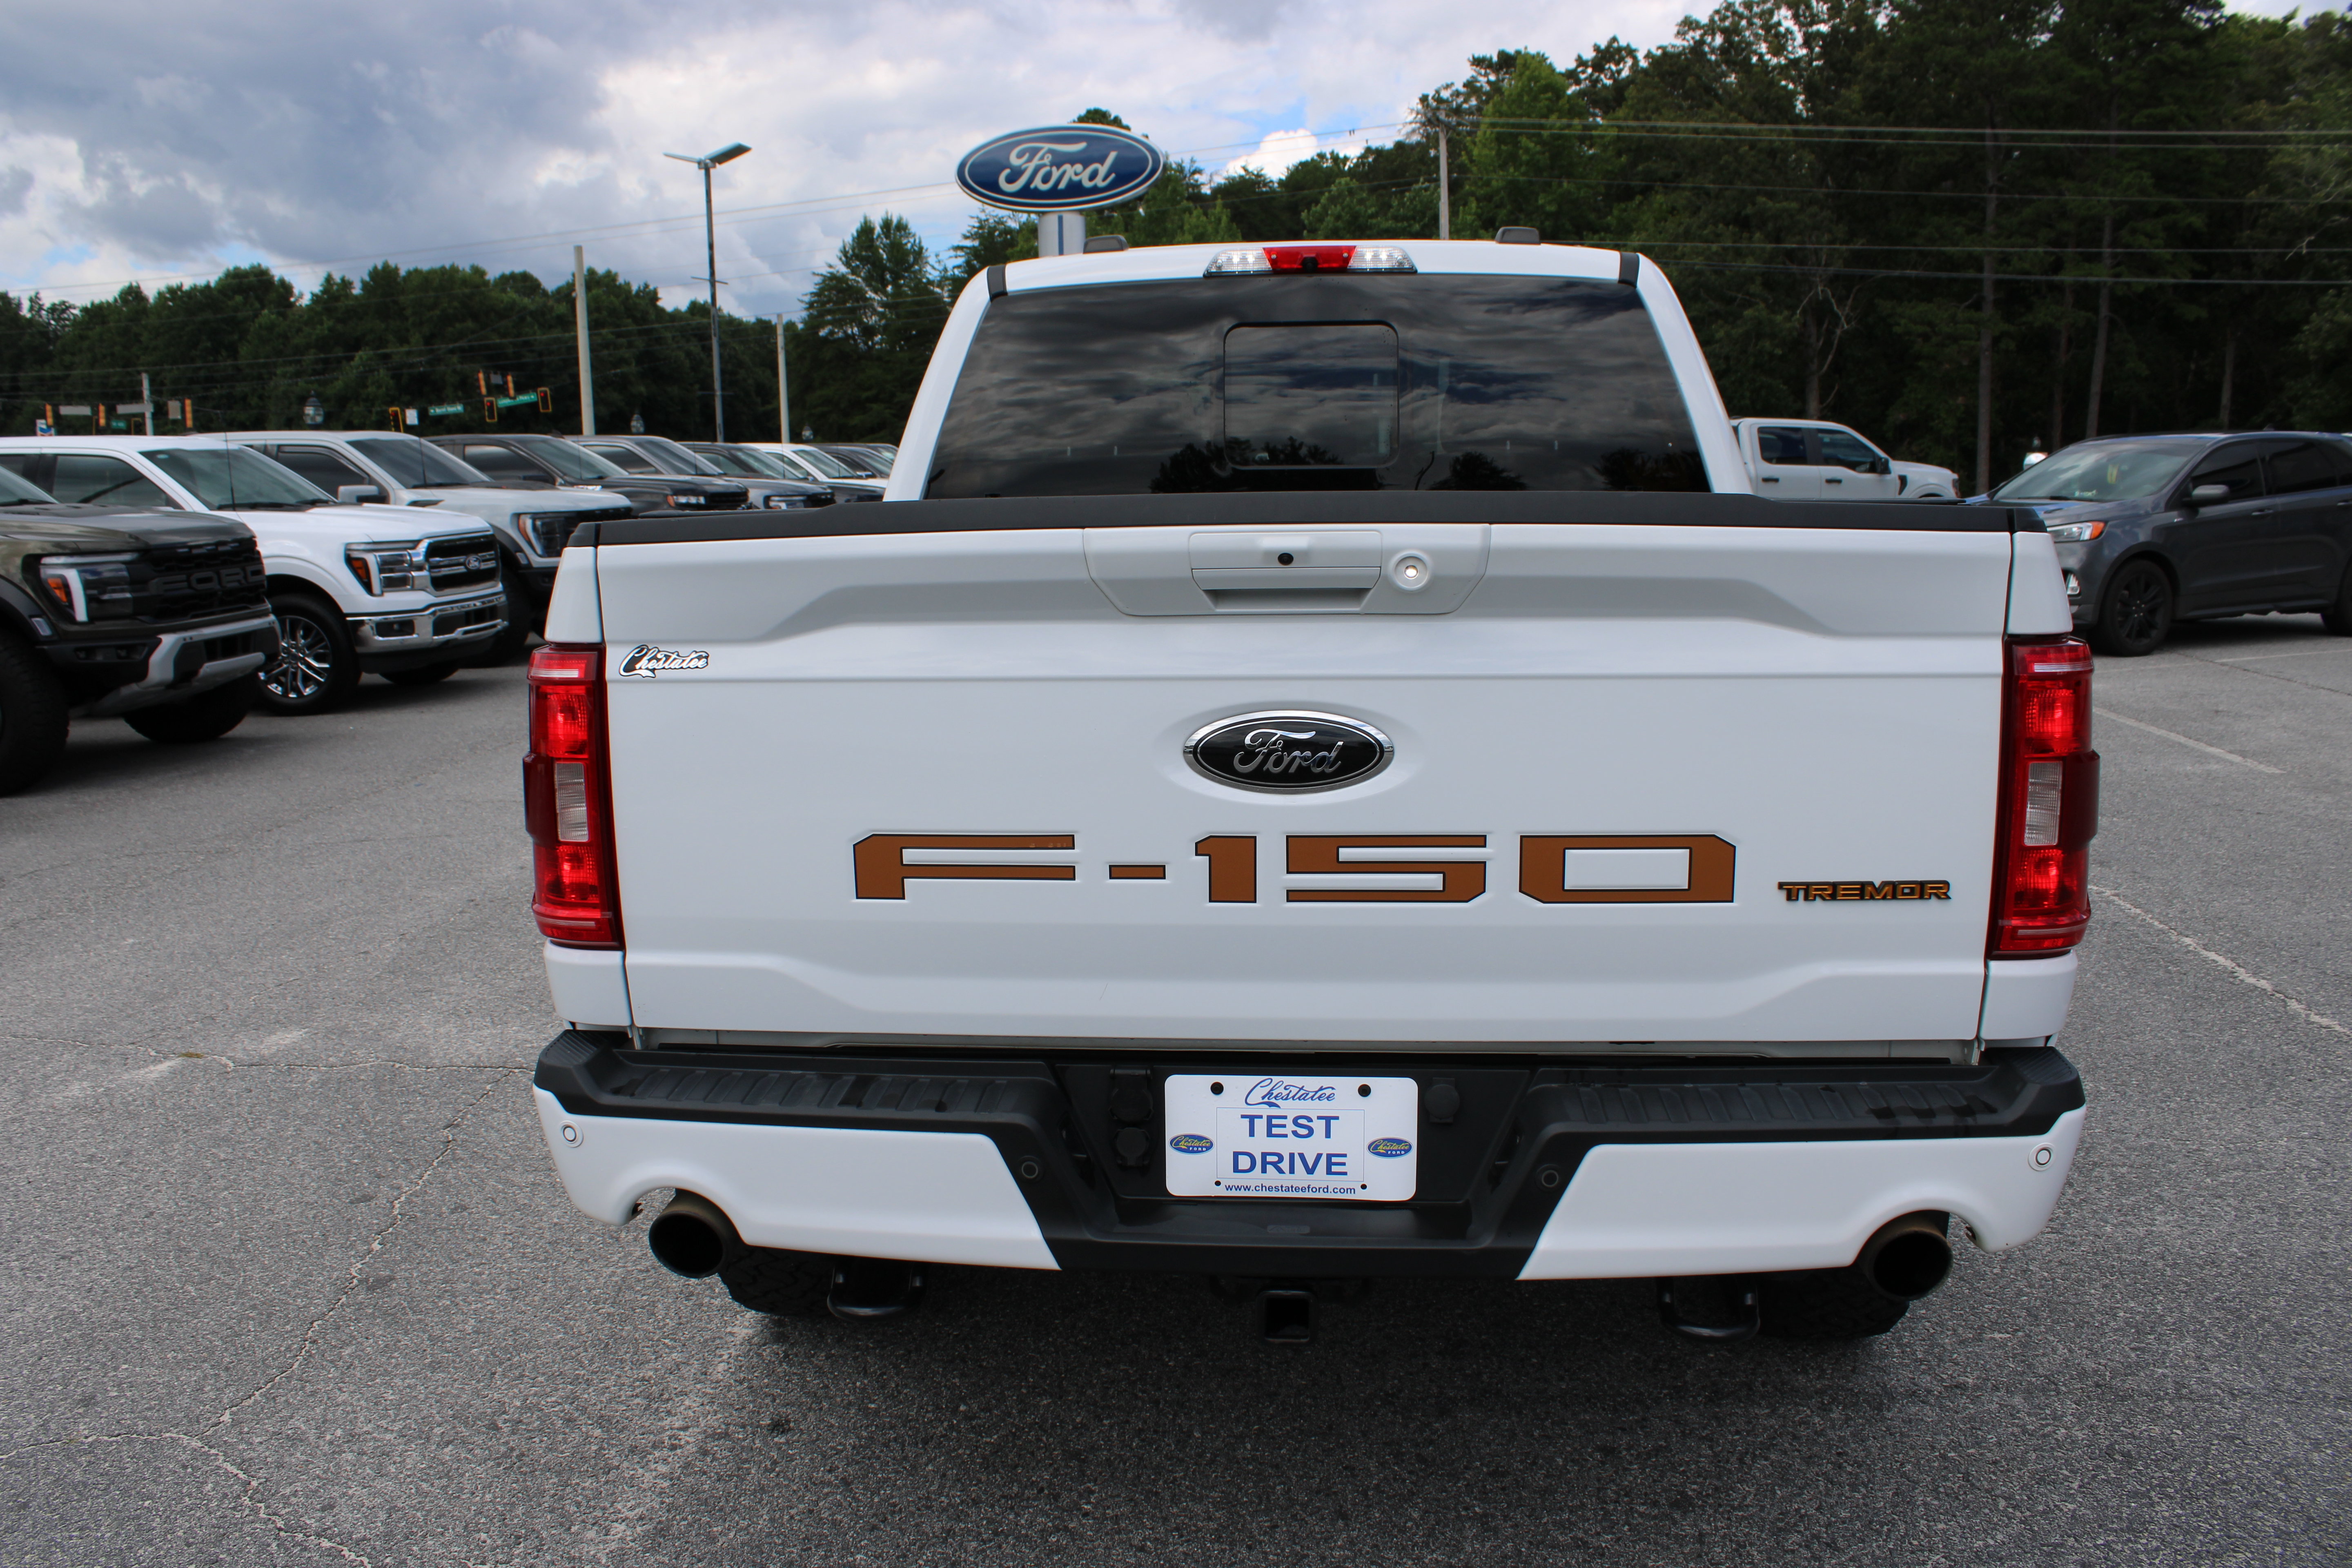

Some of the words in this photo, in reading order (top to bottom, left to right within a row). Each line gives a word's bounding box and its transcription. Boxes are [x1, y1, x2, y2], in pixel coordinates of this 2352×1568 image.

[998, 142, 1118, 192] Ford
[619, 645, 709, 677] Chestatee
[1234, 729, 1344, 773] Ford
[853, 833, 1736, 903] F-150
[1778, 880, 1951, 901] TREMOR
[1245, 1078, 1336, 1109] Chestatee
[1241, 1114, 1339, 1138] TEST
[1172, 1136, 1210, 1149] Chestatee
[1370, 1140, 1409, 1153] Chestatee
[1232, 1151, 1348, 1176] DRIVE
[1225, 1184, 1356, 1194] www.chestateeford.com
